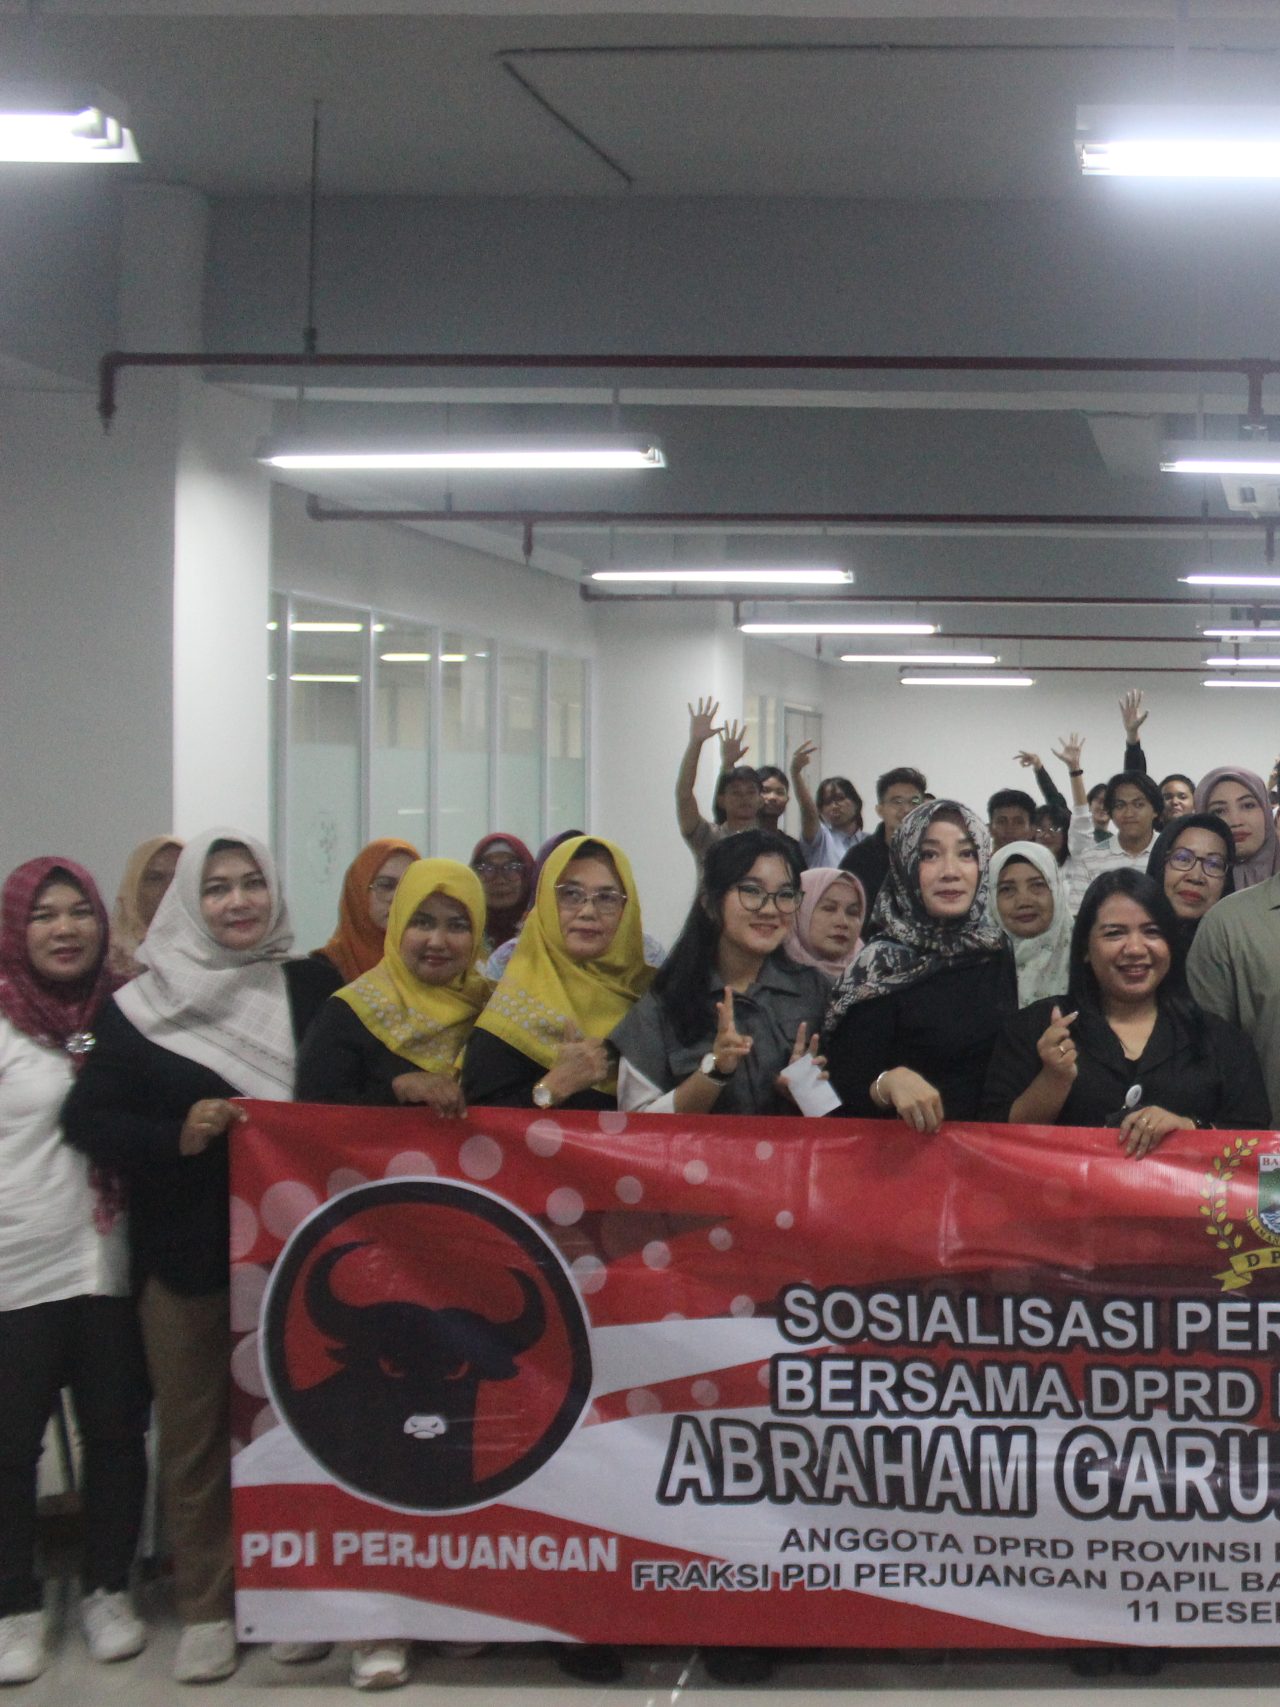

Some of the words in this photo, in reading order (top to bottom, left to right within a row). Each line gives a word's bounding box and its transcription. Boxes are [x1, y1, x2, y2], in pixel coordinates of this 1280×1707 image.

[783, 1288, 1154, 1350] SOSIALISASI
[777, 1359, 1074, 1414] BERSAMA
[1091, 1368, 1256, 1418] DPRD
[664, 1421, 1028, 1512] ABRAHAM
[241, 1531, 317, 1568] PDI
[332, 1531, 618, 1573] PERJUANGAN
[779, 1527, 964, 1554] ANGGOTA
[973, 1535, 1074, 1560] DPRD
[1086, 1539, 1261, 1563] PROVINSI
[633, 1563, 768, 1589] FRAKSI
[783, 1563, 841, 1589] PDI
[854, 1563, 1107, 1589] PERJUANGAN
[1120, 1571, 1229, 1592] DAPIL
[1126, 1600, 1160, 1623] 11
